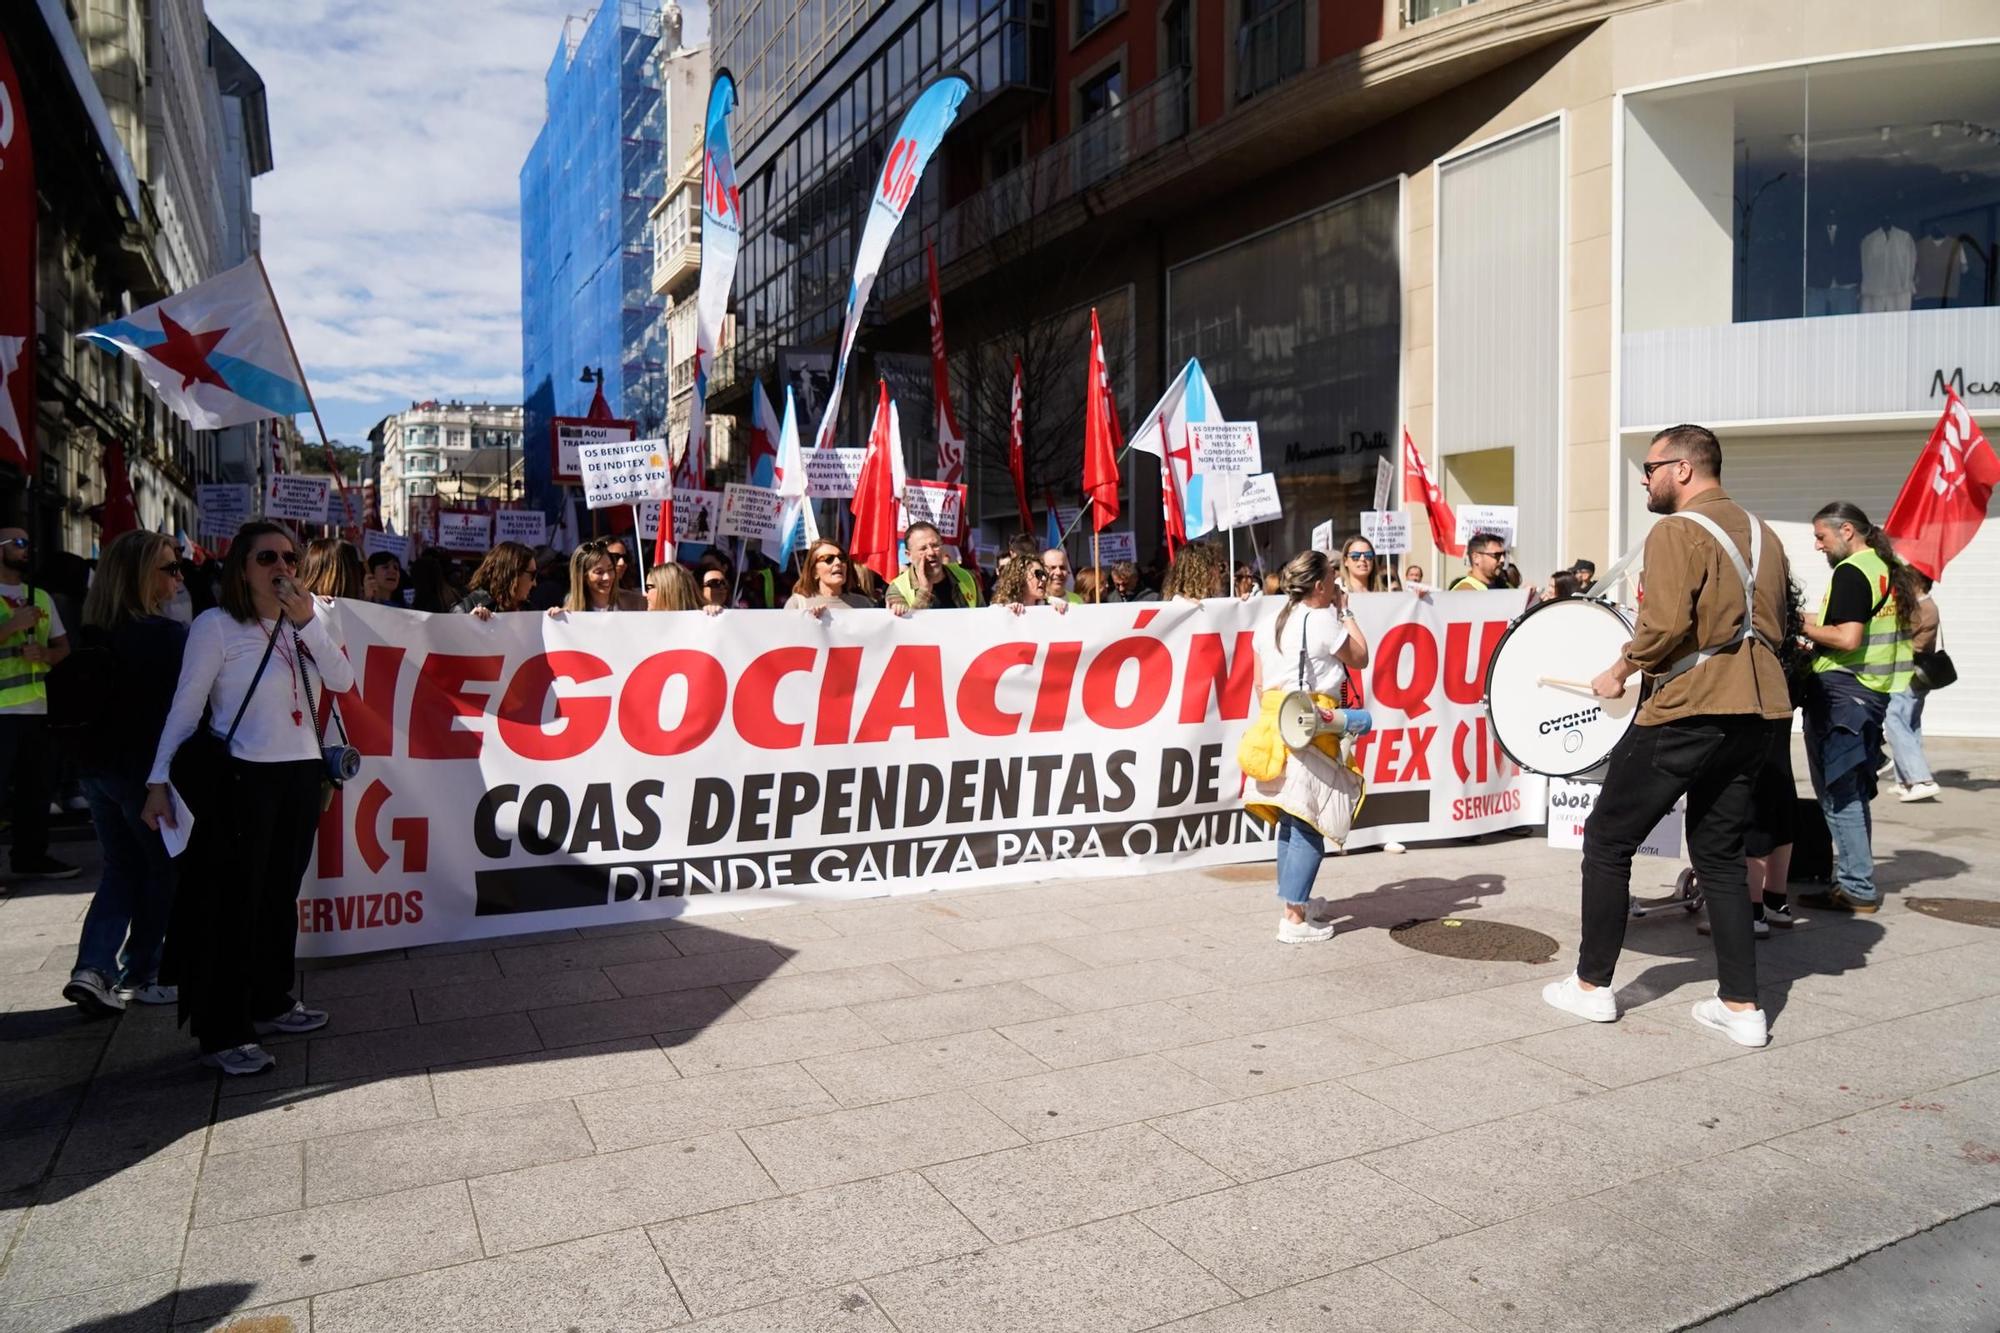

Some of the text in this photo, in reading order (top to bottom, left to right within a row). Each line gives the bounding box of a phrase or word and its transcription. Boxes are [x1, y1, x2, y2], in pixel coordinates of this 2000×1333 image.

[584, 430, 607, 438] AQUÍ
[601, 444, 656, 456] BENEFICIOS
[588, 459, 645, 472] DE INDITEX
[645, 472, 665, 480] VEN
[589, 493, 612, 502] DOUS
[615, 491, 627, 500] OU
[320, 609, 1254, 761] NEGOCIACIÓN
[474, 779, 665, 858] COAS
[687, 749, 1137, 846] DEPENDENTAS
[1157, 743, 1222, 808] DE
[1452, 789, 1520, 821] SERVIZOS
[316, 779, 429, 879] IG
[607, 853, 795, 904] DENDE
[811, 837, 988, 883] GALIZA
[996, 827, 1104, 865] PARA
[1123, 822, 1158, 858] O
[299, 891, 423, 933] ERVIZOS
